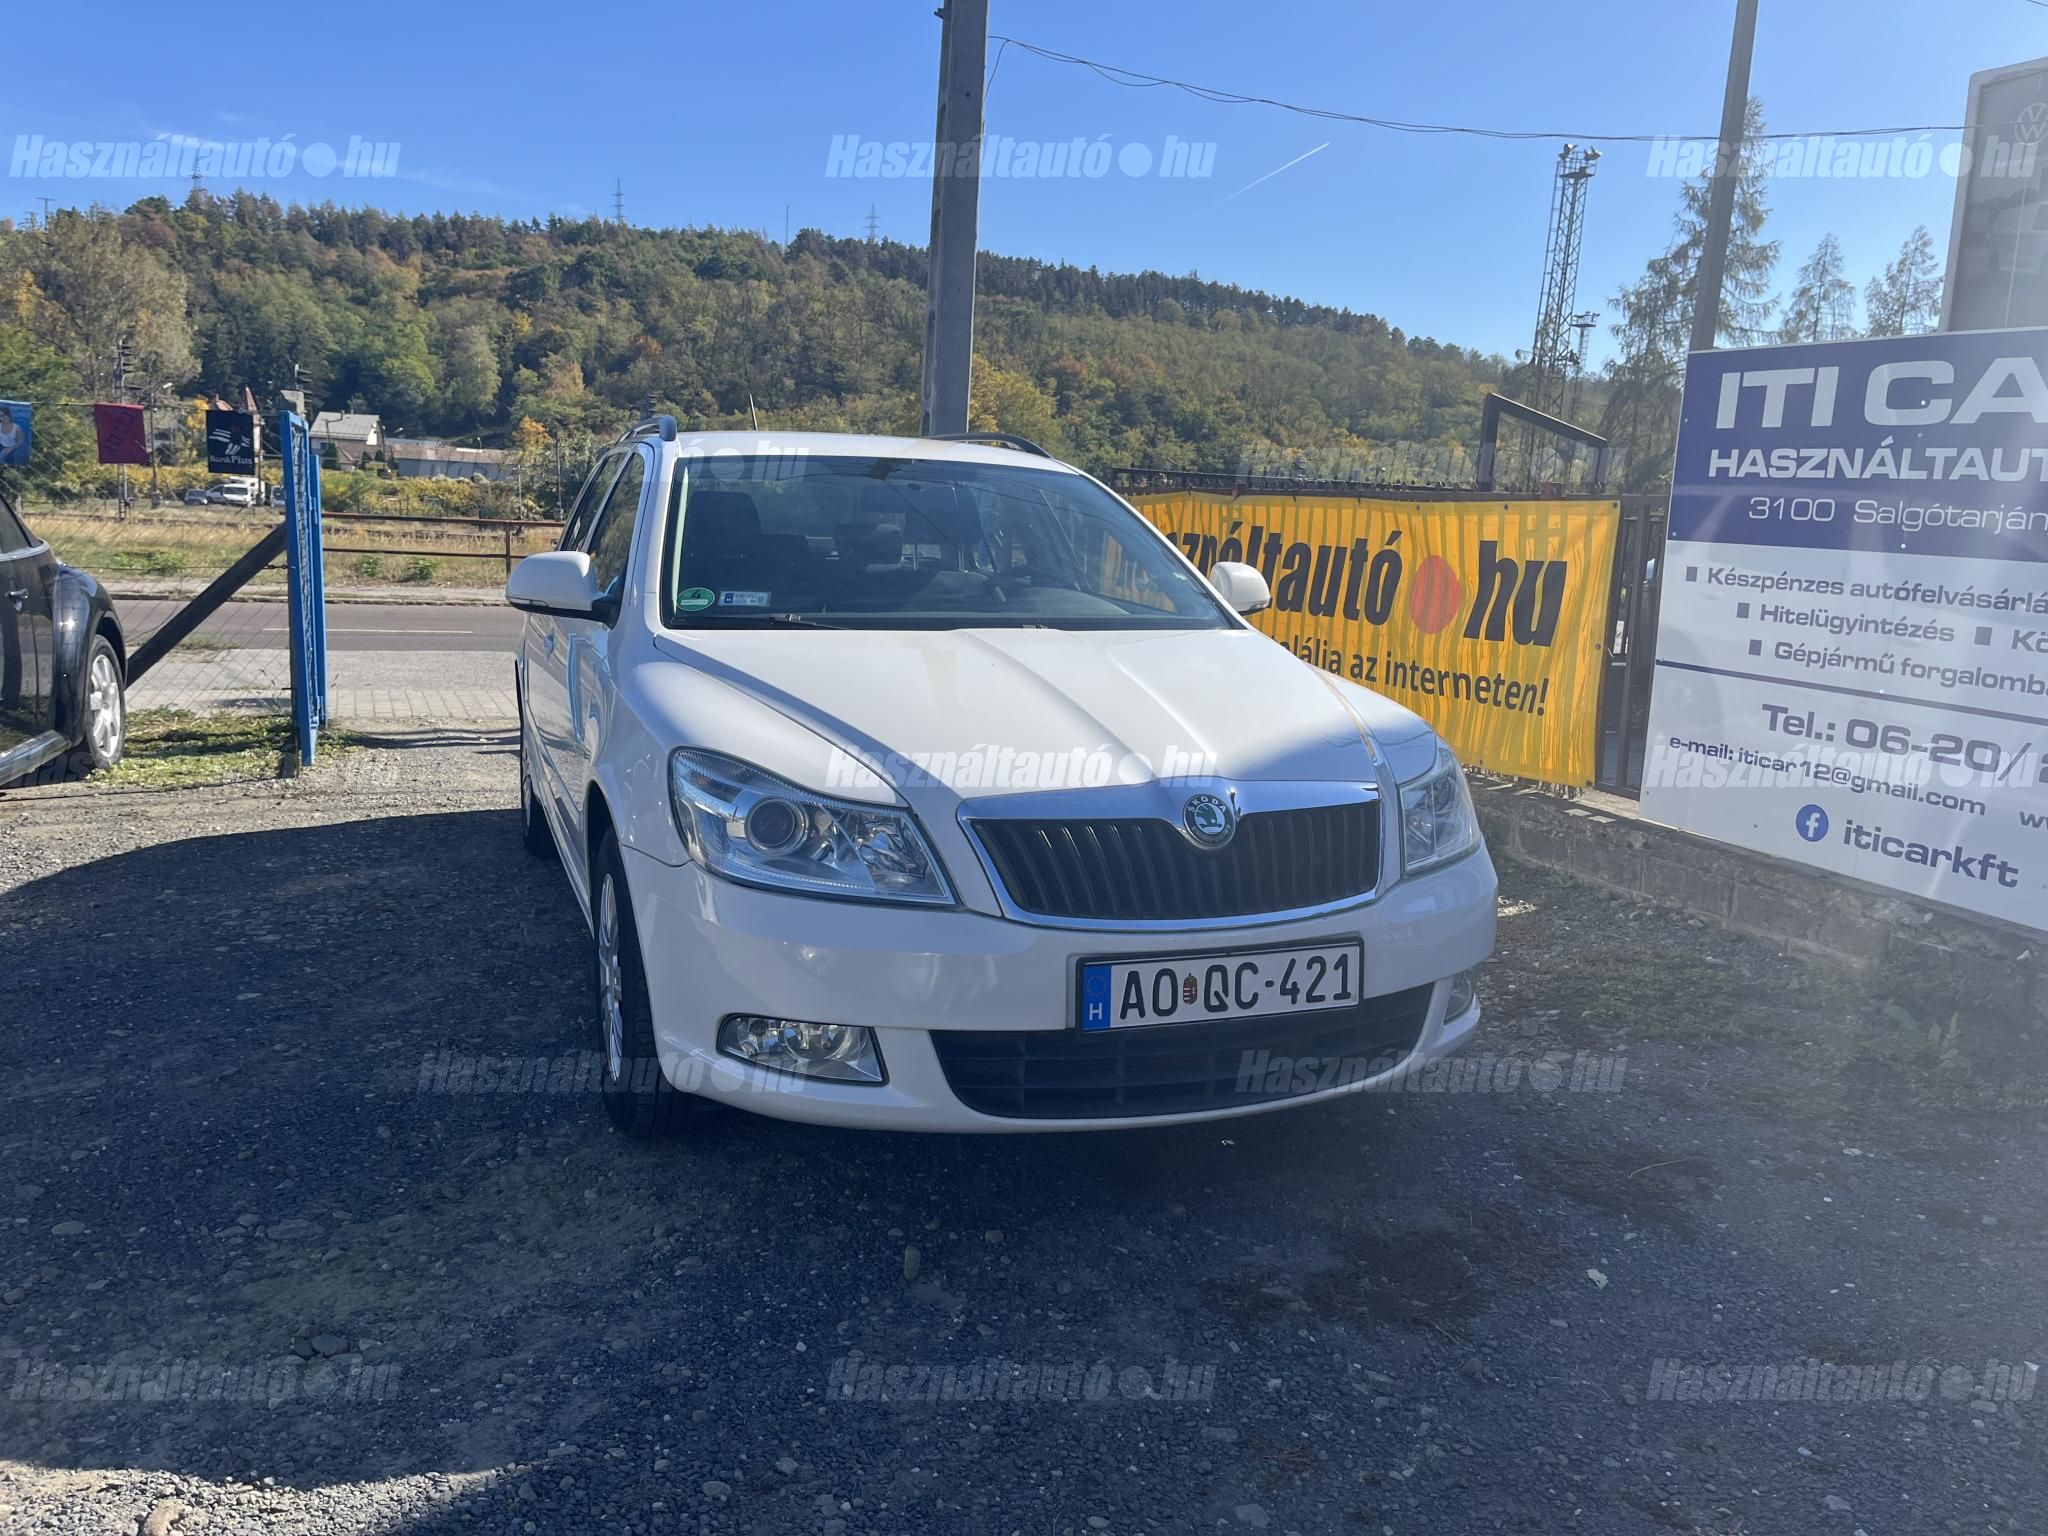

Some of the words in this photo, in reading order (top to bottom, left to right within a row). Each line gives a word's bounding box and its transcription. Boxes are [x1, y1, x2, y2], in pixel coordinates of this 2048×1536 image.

[1716, 366, 1839, 429] ITI
[1749, 497, 1836, 522] 3100
[1707, 567, 1845, 595] Készpénzes
[1760, 603, 1955, 643] Hitelügyintézés
[1350, 653, 1377, 683] az
[1385, 651, 1550, 717] interneten!
[1774, 641, 1895, 675] Gépjármű
[1901, 656, 2048, 698] forgalomb
[1762, 703, 1835, 743] Tel.:
[1669, 736, 1733, 761] e-mail:
[1738, 747, 1986, 816] iticar12@gmail.com
[1843, 819, 2019, 888] iticarkft
[1088, 1002, 1103, 1021] H
